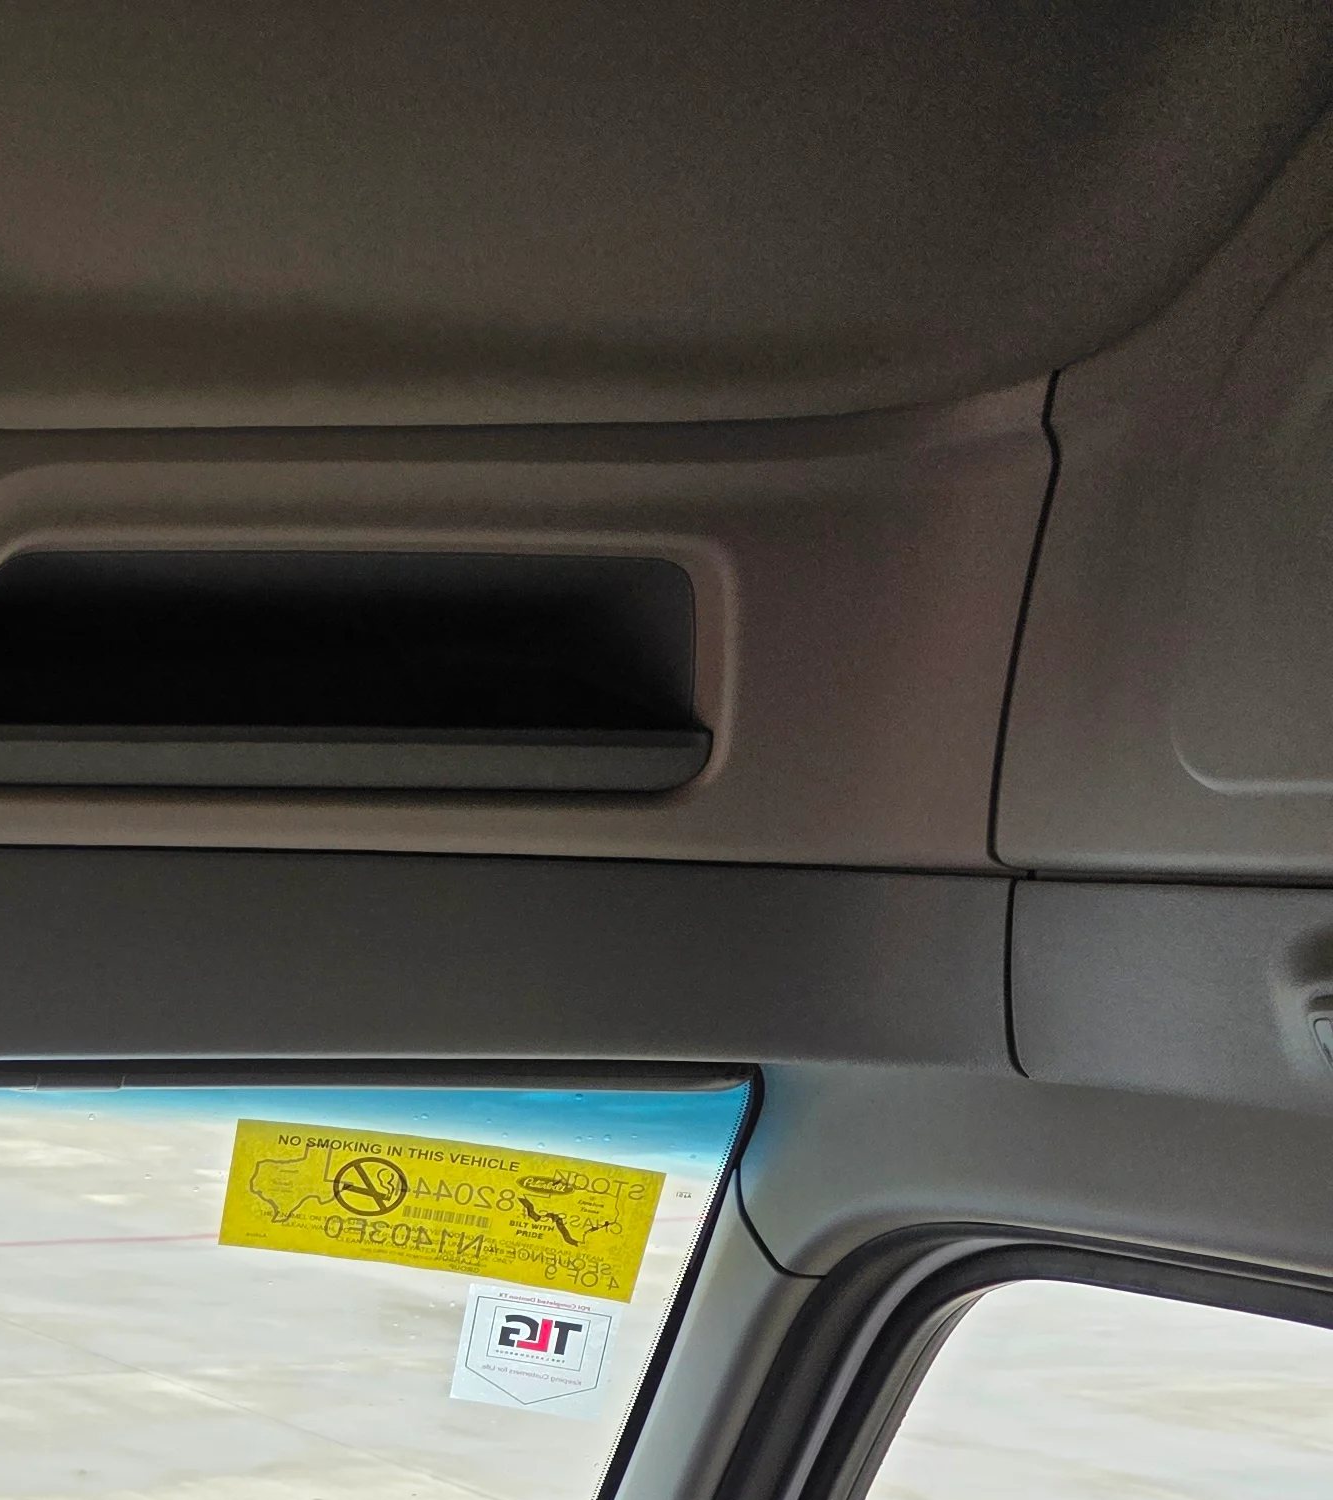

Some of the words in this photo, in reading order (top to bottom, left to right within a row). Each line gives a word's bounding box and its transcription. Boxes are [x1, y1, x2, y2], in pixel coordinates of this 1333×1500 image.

[278, 1135, 301, 1146] NO
[307, 1137, 382, 1154] SMOKING
[387, 1145, 402, 1157] IN
[408, 1148, 444, 1162] THIS
[450, 1153, 521, 1172] VEHICLE
[509, 1220, 529, 1230] BILT
[531, 1222, 555, 1232] WITH
[516, 1230, 544, 1239] PRIDE
